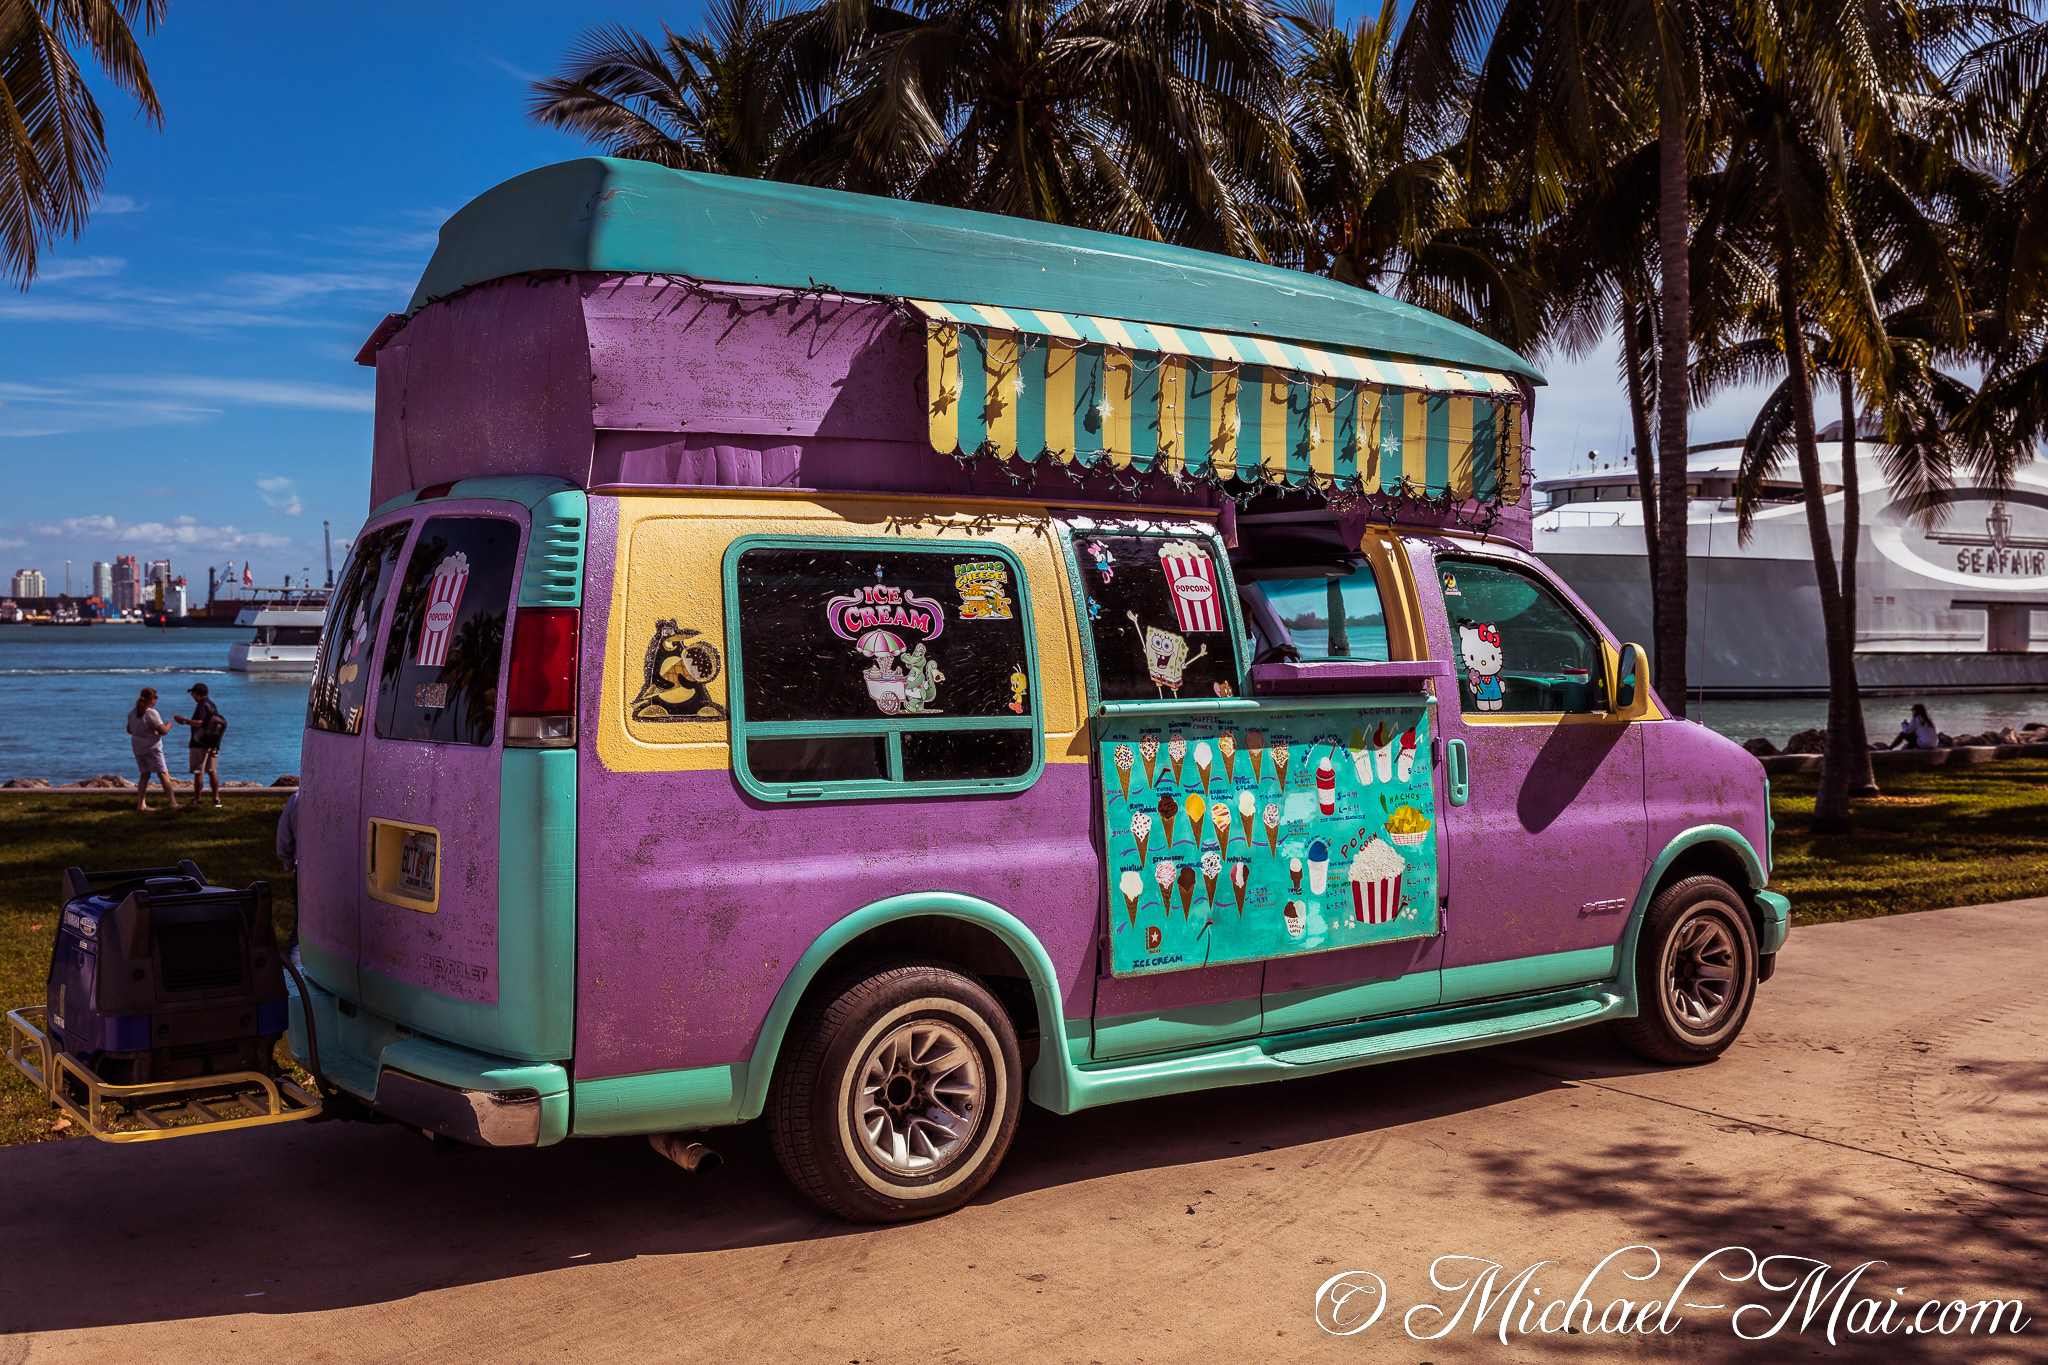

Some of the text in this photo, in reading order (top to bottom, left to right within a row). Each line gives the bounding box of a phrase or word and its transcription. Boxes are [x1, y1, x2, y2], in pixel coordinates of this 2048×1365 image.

[955, 562, 1004, 576] NACHO
[1957, 548, 2045, 575] SEAFAIR
[956, 572, 1007, 588] CHEESE!
[863, 584, 902, 605] ICE
[1175, 584, 1210, 593] POPCORN
[428, 612, 452, 622] POPCORN
[844, 605, 930, 633] CREAM
[1390, 793, 1420, 804] NACHOS
[1341, 828, 1366, 859] POP
[1133, 955, 1182, 968] ICE CREAM
